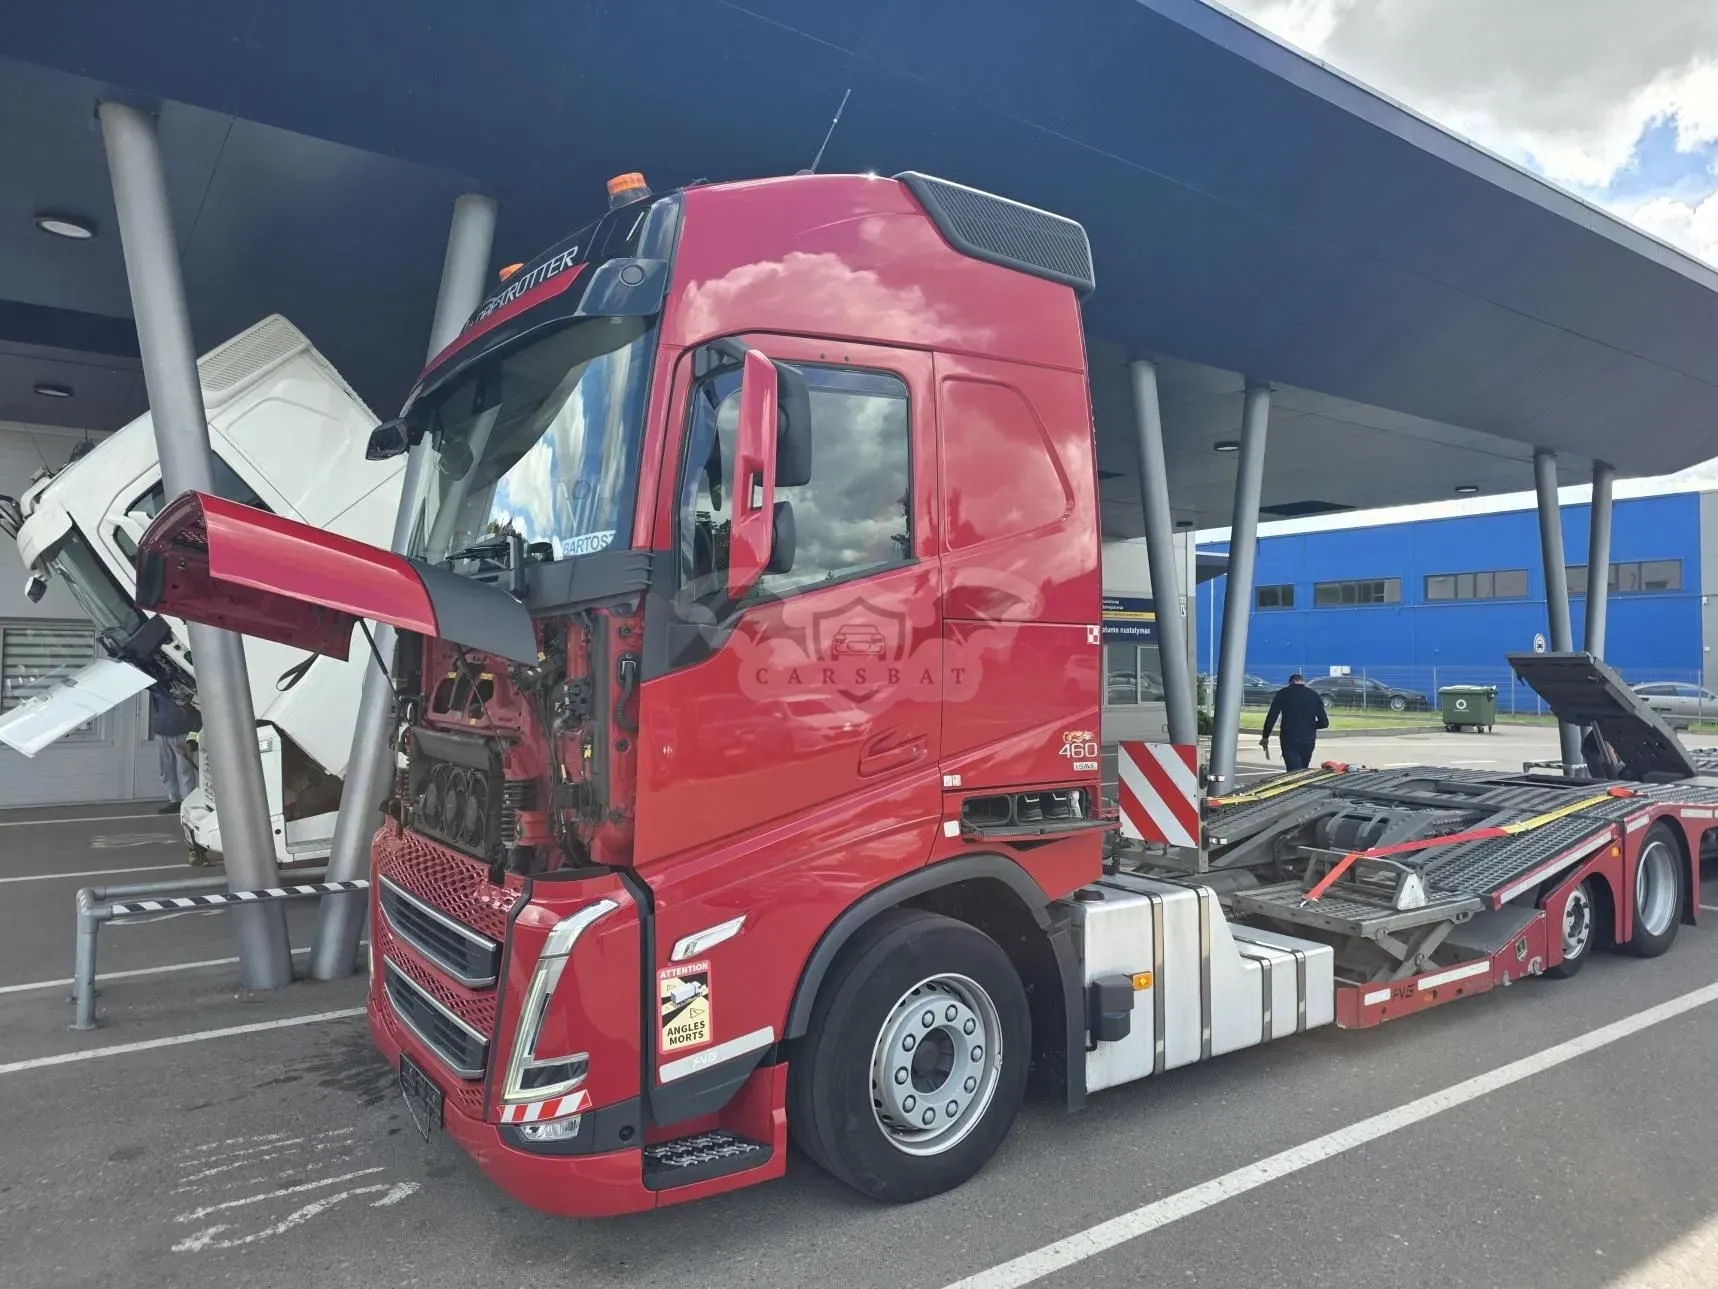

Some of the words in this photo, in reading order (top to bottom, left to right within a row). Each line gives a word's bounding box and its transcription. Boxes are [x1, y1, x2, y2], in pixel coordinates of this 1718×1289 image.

[562, 533, 615, 555] BARTOS
[1120, 626, 1151, 636] nustatymas
[1059, 742, 1098, 758] 460
[660, 962, 709, 979] ATTENTION
[667, 1020, 706, 1036] ANGLES
[669, 1030, 704, 1045] MORTS
